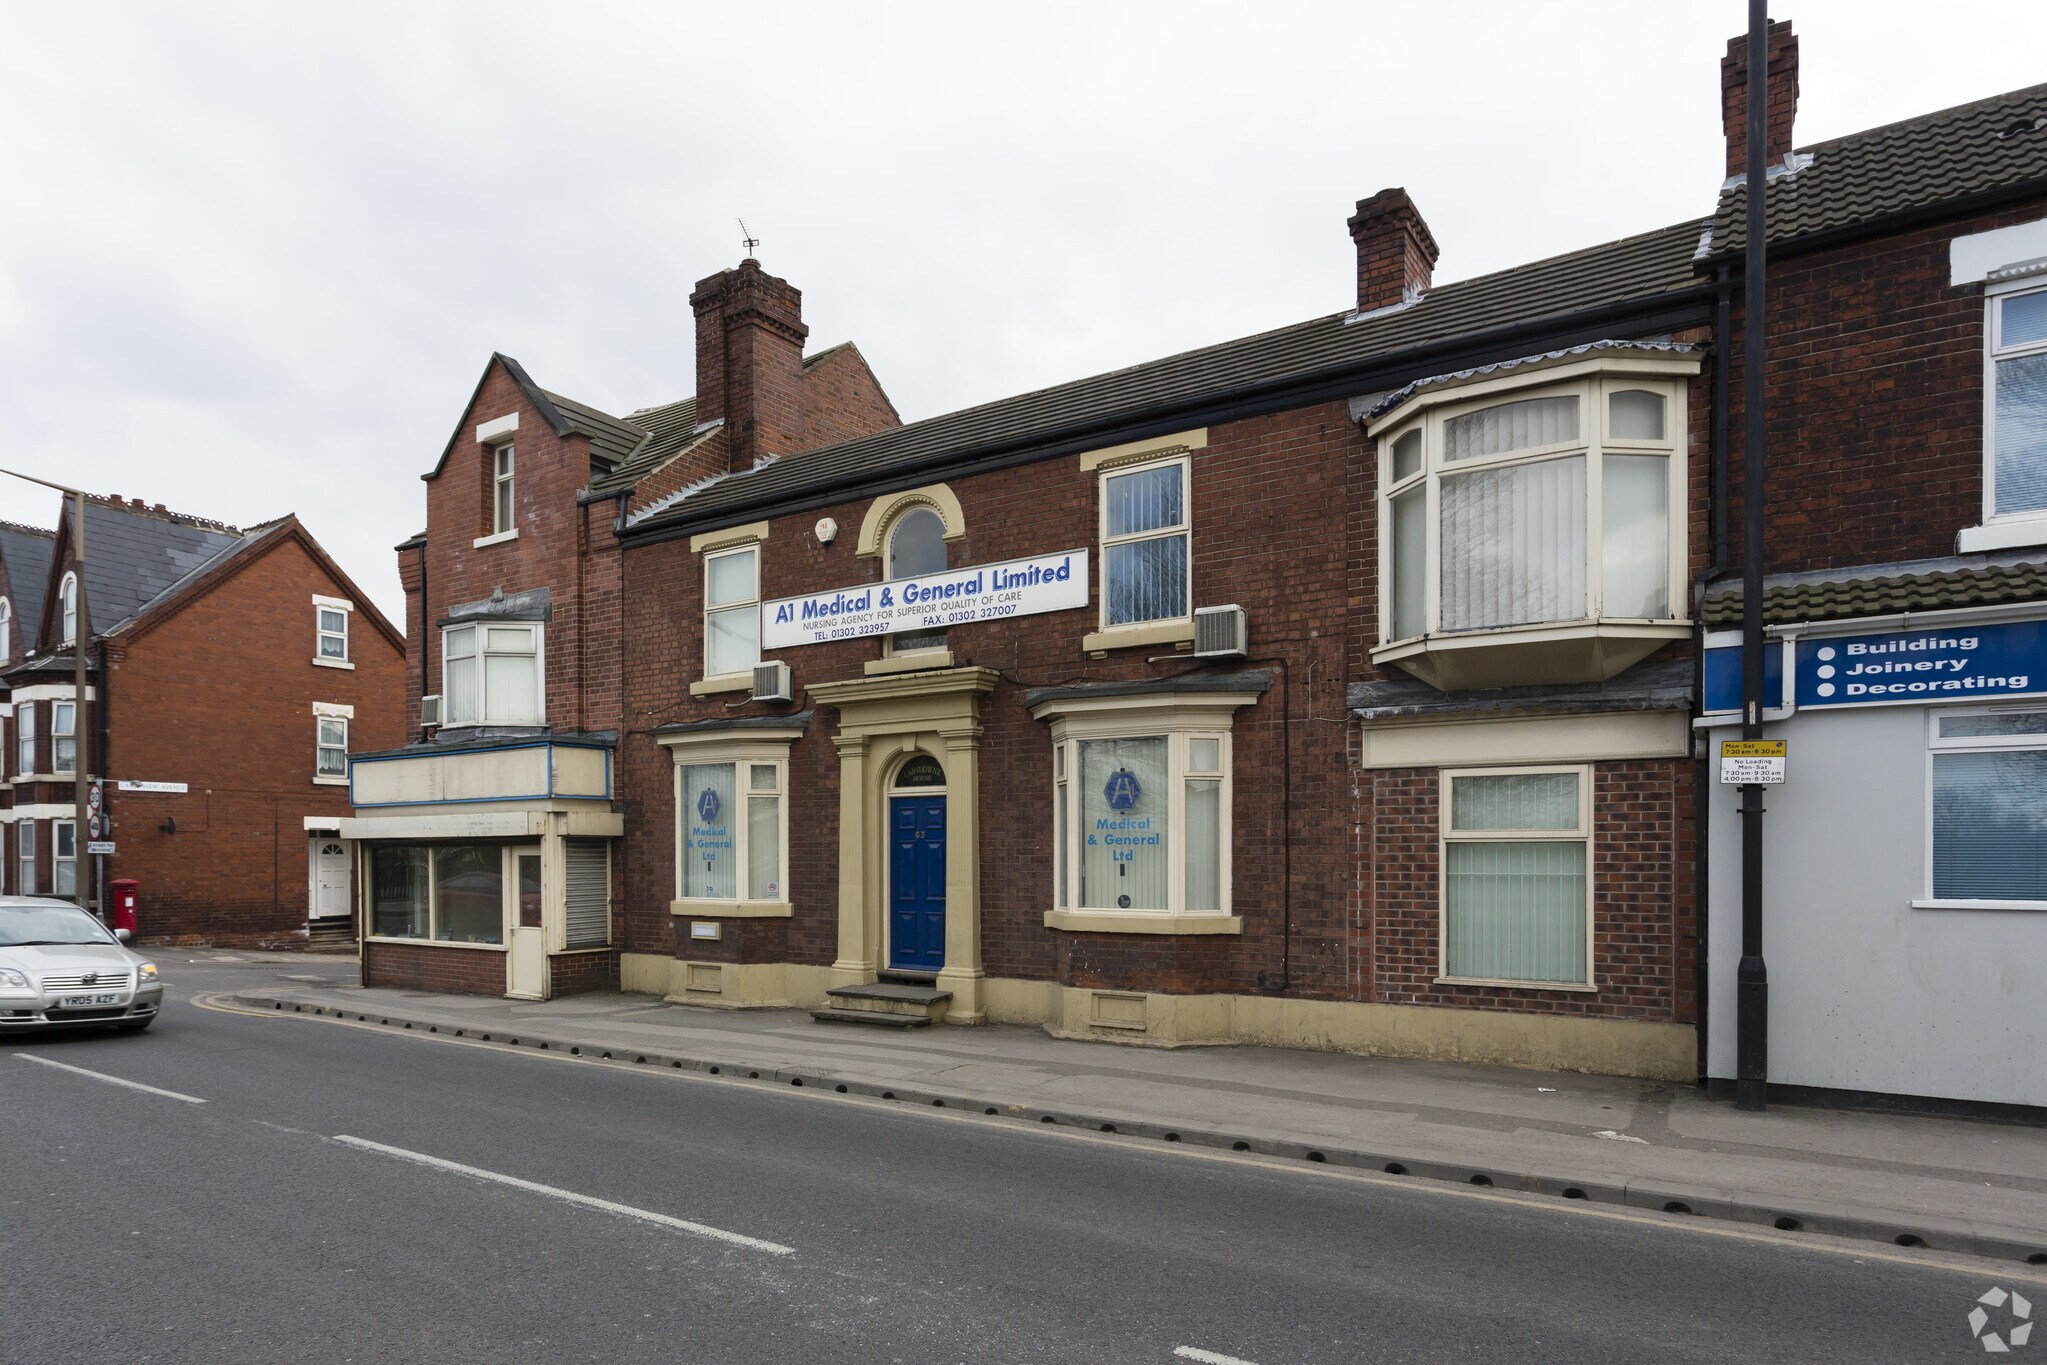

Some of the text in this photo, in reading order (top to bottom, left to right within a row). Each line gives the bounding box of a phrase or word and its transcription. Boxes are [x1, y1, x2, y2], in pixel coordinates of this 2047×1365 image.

[775, 556, 1070, 625] A1 Medical & General Limited
[803, 591, 1022, 631] NURSING AGENCY FOR SUPERIOR QUALITY OF CARE
[814, 604, 1017, 641] TEL: 01302 323957 FAX: 01302 327007
[1847, 637, 1979, 655] Building
[1845, 658, 1969, 676] Joinery
[1846, 675, 2029, 696] Decorating
[91, 791, 100, 803] 30
[1096, 817, 1150, 830] Medical
[692, 826, 726, 836] Medical
[915, 830, 925, 839] 63
[687, 838, 732, 849] & General
[1087, 832, 1160, 846] & General
[702, 851, 716, 861] Ltd
[1112, 849, 1134, 861] Ltd
[64, 994, 116, 1006] YR05 AZF
